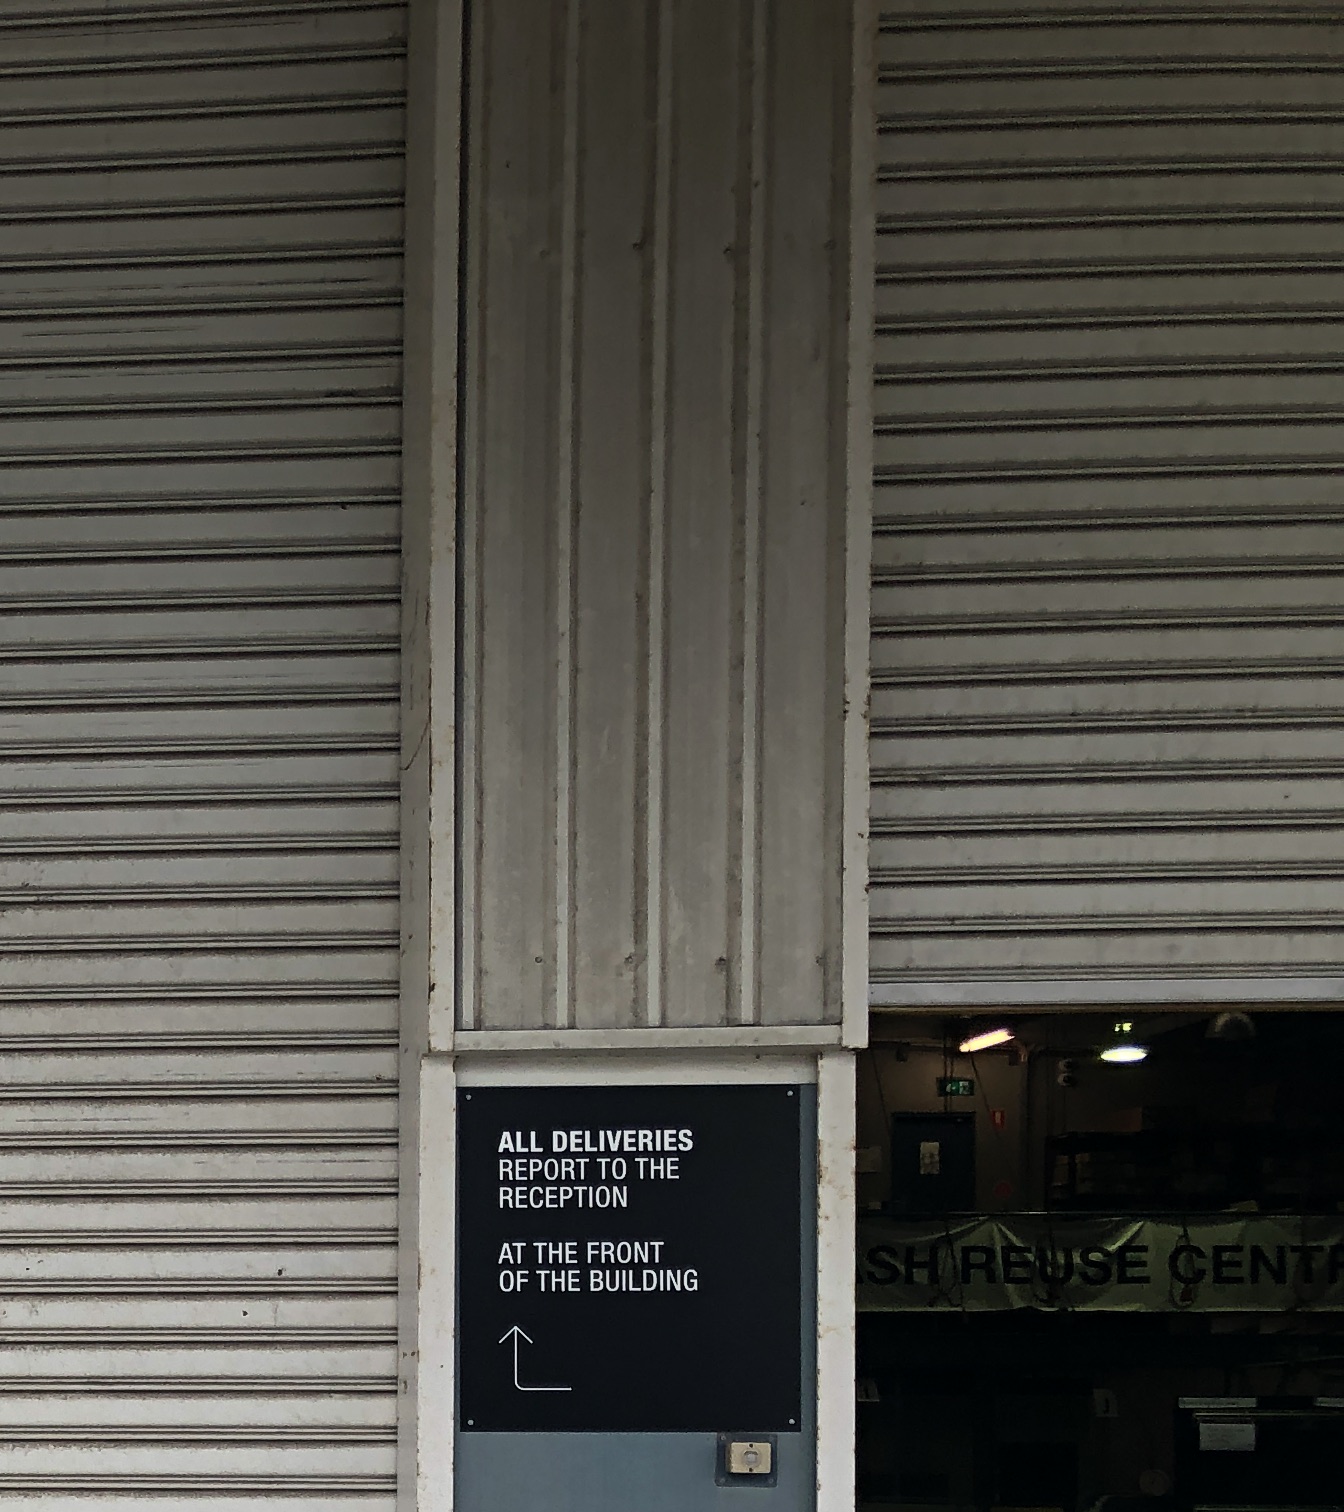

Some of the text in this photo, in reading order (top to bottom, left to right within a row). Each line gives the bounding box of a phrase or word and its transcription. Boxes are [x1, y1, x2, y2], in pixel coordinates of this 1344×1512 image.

[498, 1129, 694, 1153] ALL DELIVERIES
[498, 1157, 680, 1181] REPORT TO THE
[498, 1185, 628, 1209] RECEPTION
[497, 1241, 665, 1265] AT THE FRONT
[856, 1245, 940, 1285] SH
[960, 1244, 1150, 1285] REUSE
[498, 1268, 698, 1293] OF THE BUILDING
